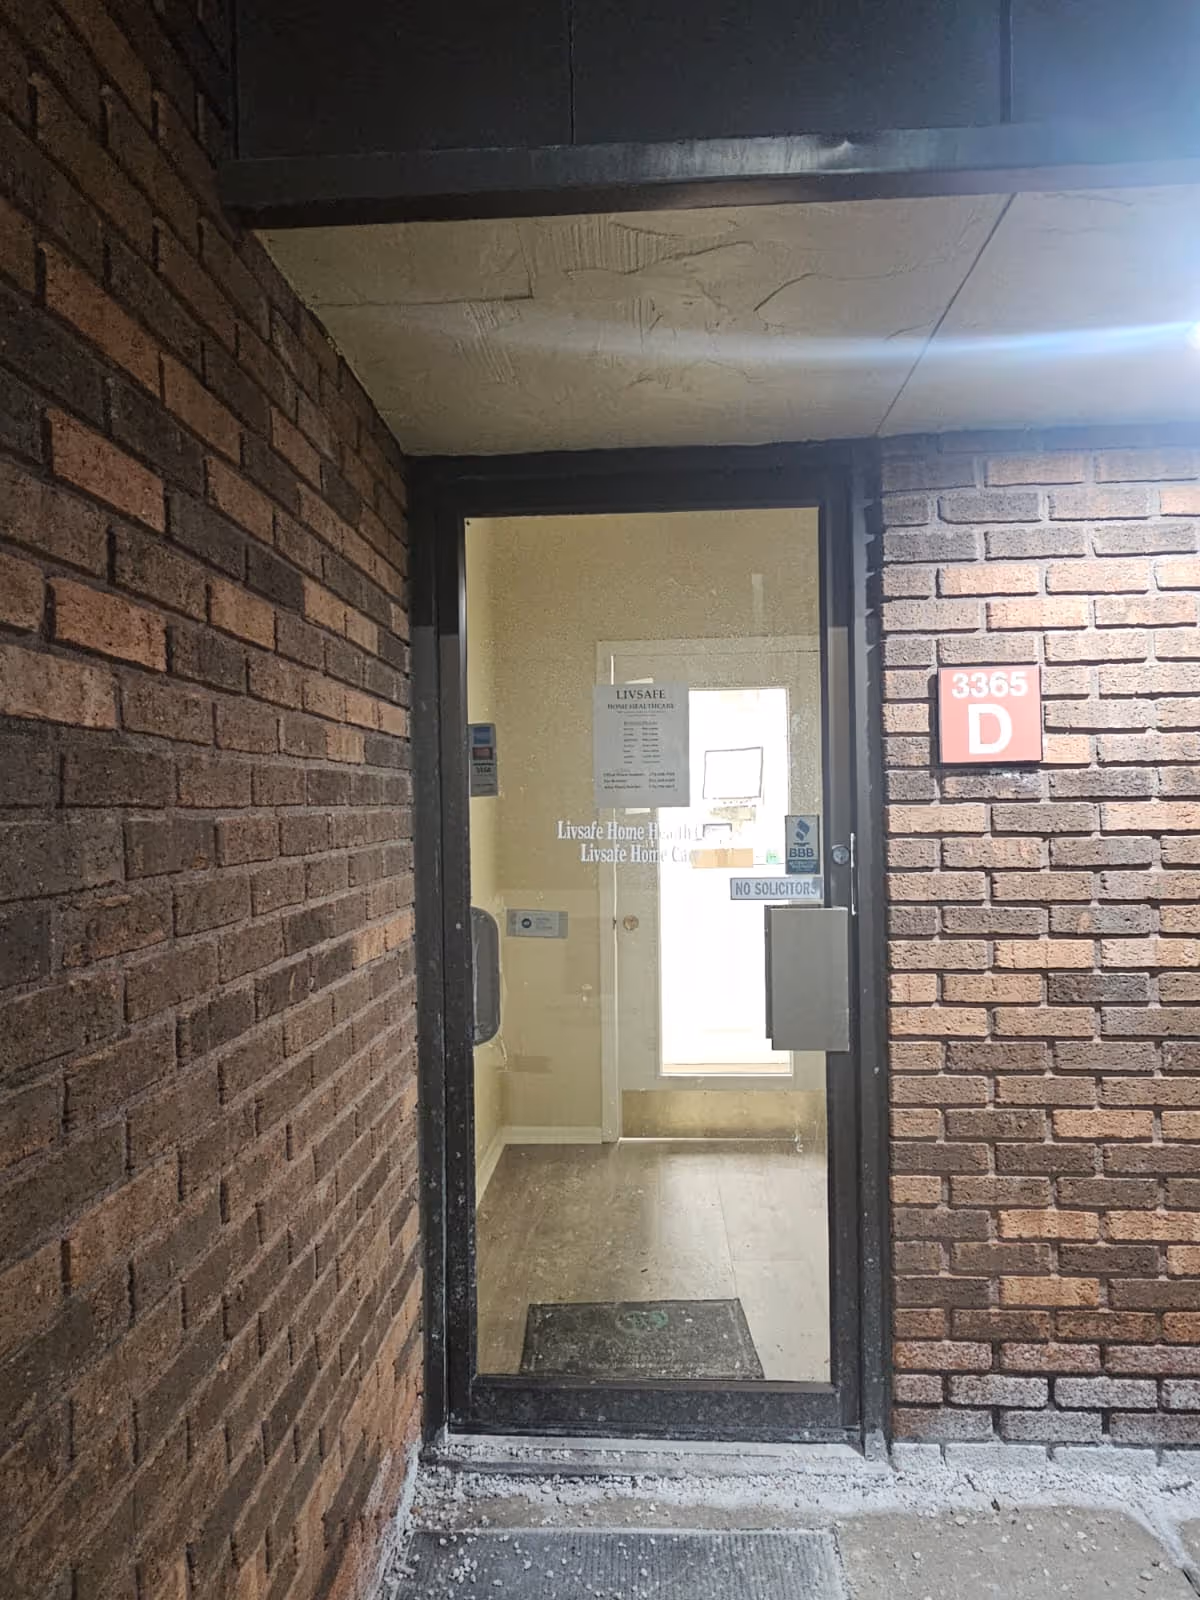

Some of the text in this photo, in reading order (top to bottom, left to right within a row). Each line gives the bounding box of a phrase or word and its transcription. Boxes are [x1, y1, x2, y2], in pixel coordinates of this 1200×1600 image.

[616, 689, 667, 700] LIVSAFE
[952, 671, 1028, 698] 3365
[968, 703, 1012, 755] D
[557, 820, 603, 840] Livsafe
[607, 821, 645, 840] Home
[580, 843, 626, 863] Livsafe
[630, 843, 668, 863] Home
[789, 847, 814, 858] BBB
[735, 880, 817, 896] NO SOLICITORS
